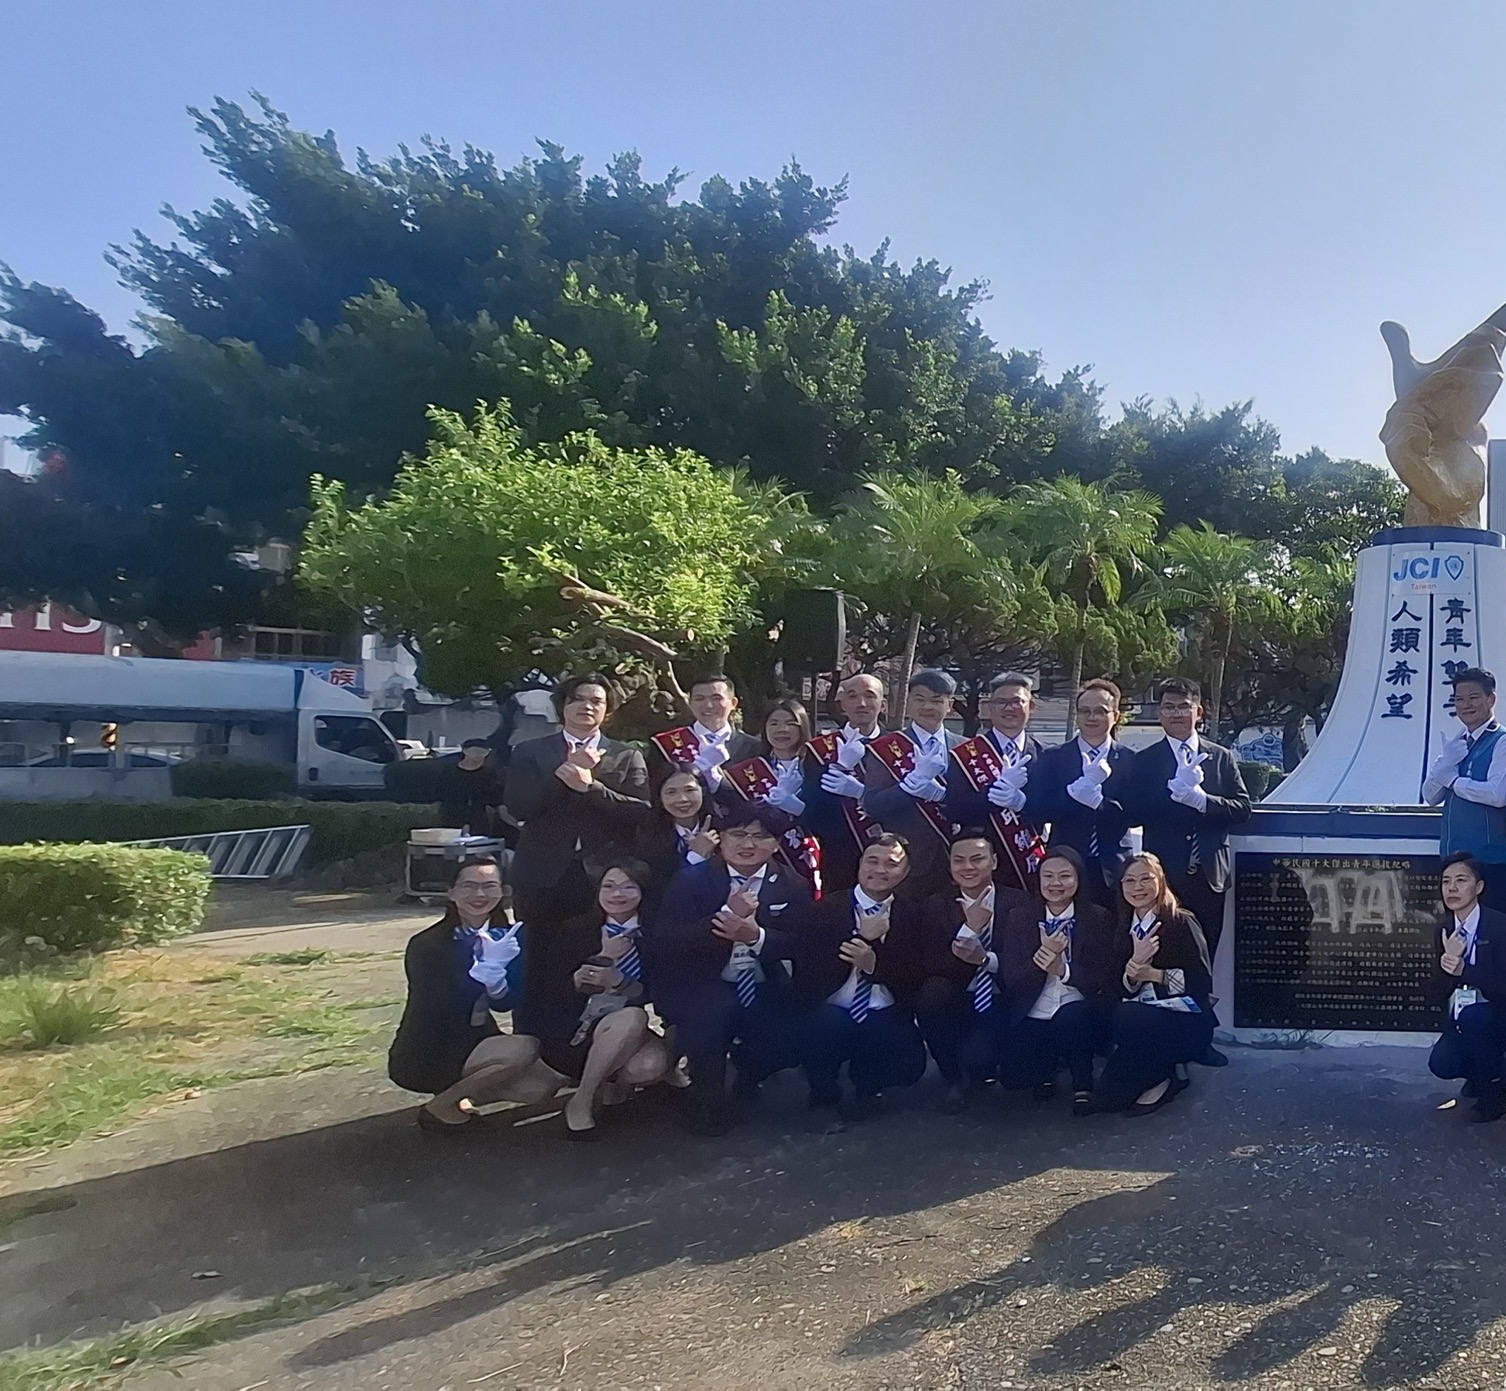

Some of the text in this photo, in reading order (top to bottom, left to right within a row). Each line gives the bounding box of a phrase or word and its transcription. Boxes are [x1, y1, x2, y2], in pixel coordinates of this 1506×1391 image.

[1393, 557, 1441, 582] JCI
[1410, 583, 1437, 591] Taiwan
[1380, 600, 1423, 719] 人類希望
